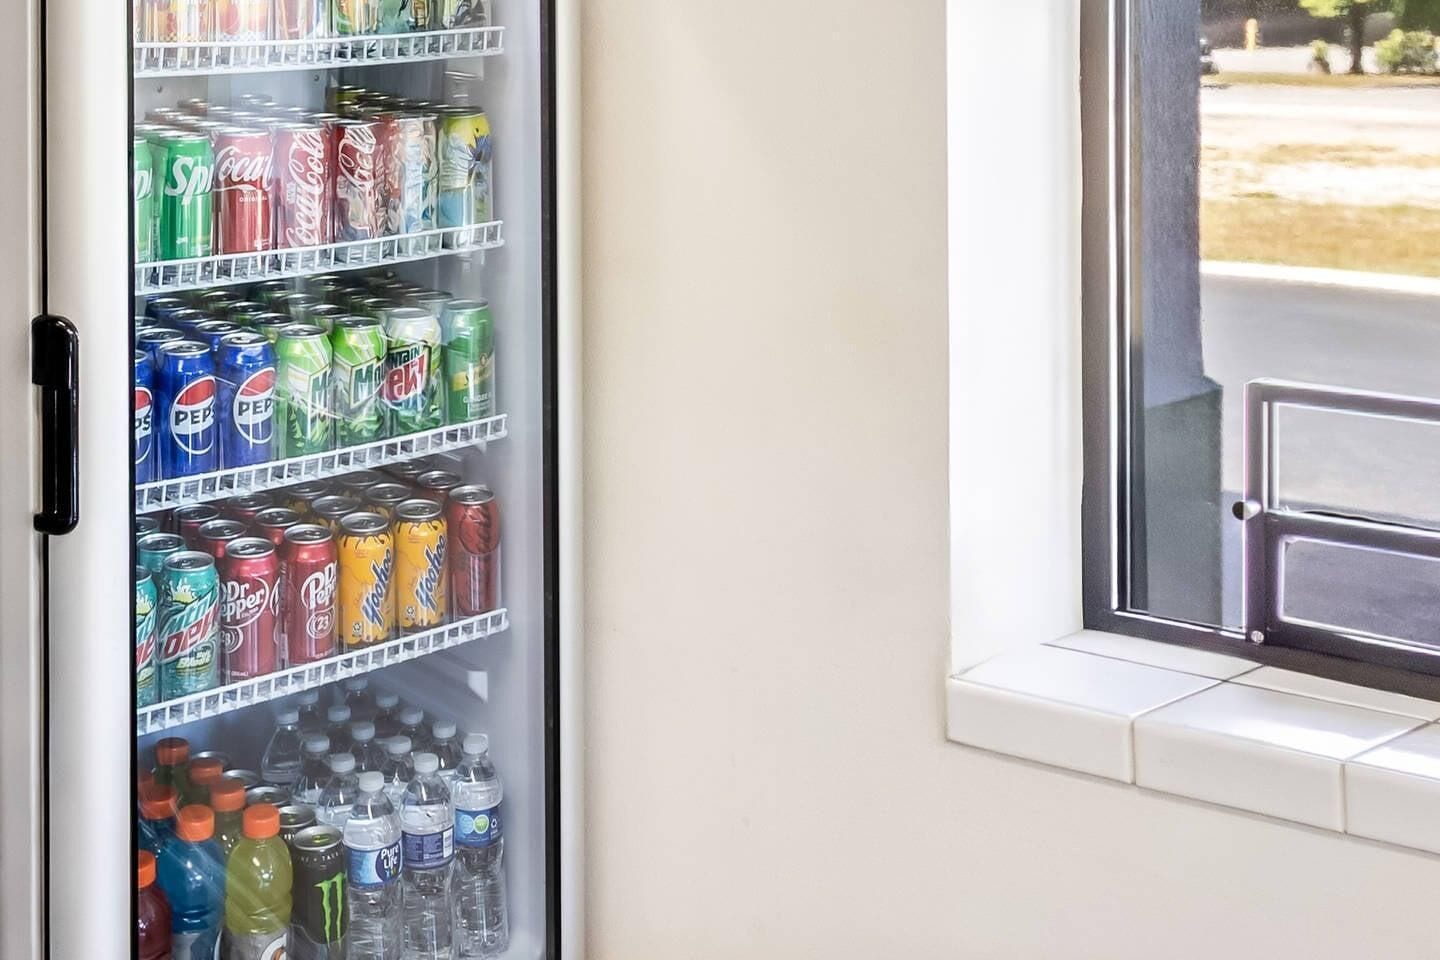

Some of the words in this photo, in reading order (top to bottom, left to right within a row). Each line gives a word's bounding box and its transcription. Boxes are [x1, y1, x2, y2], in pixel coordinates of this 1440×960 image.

[228, 581, 250, 603] Dr
[316, 616, 329, 631] 23
[380, 844, 400, 860] Pure
[383, 855, 399, 869] Life
